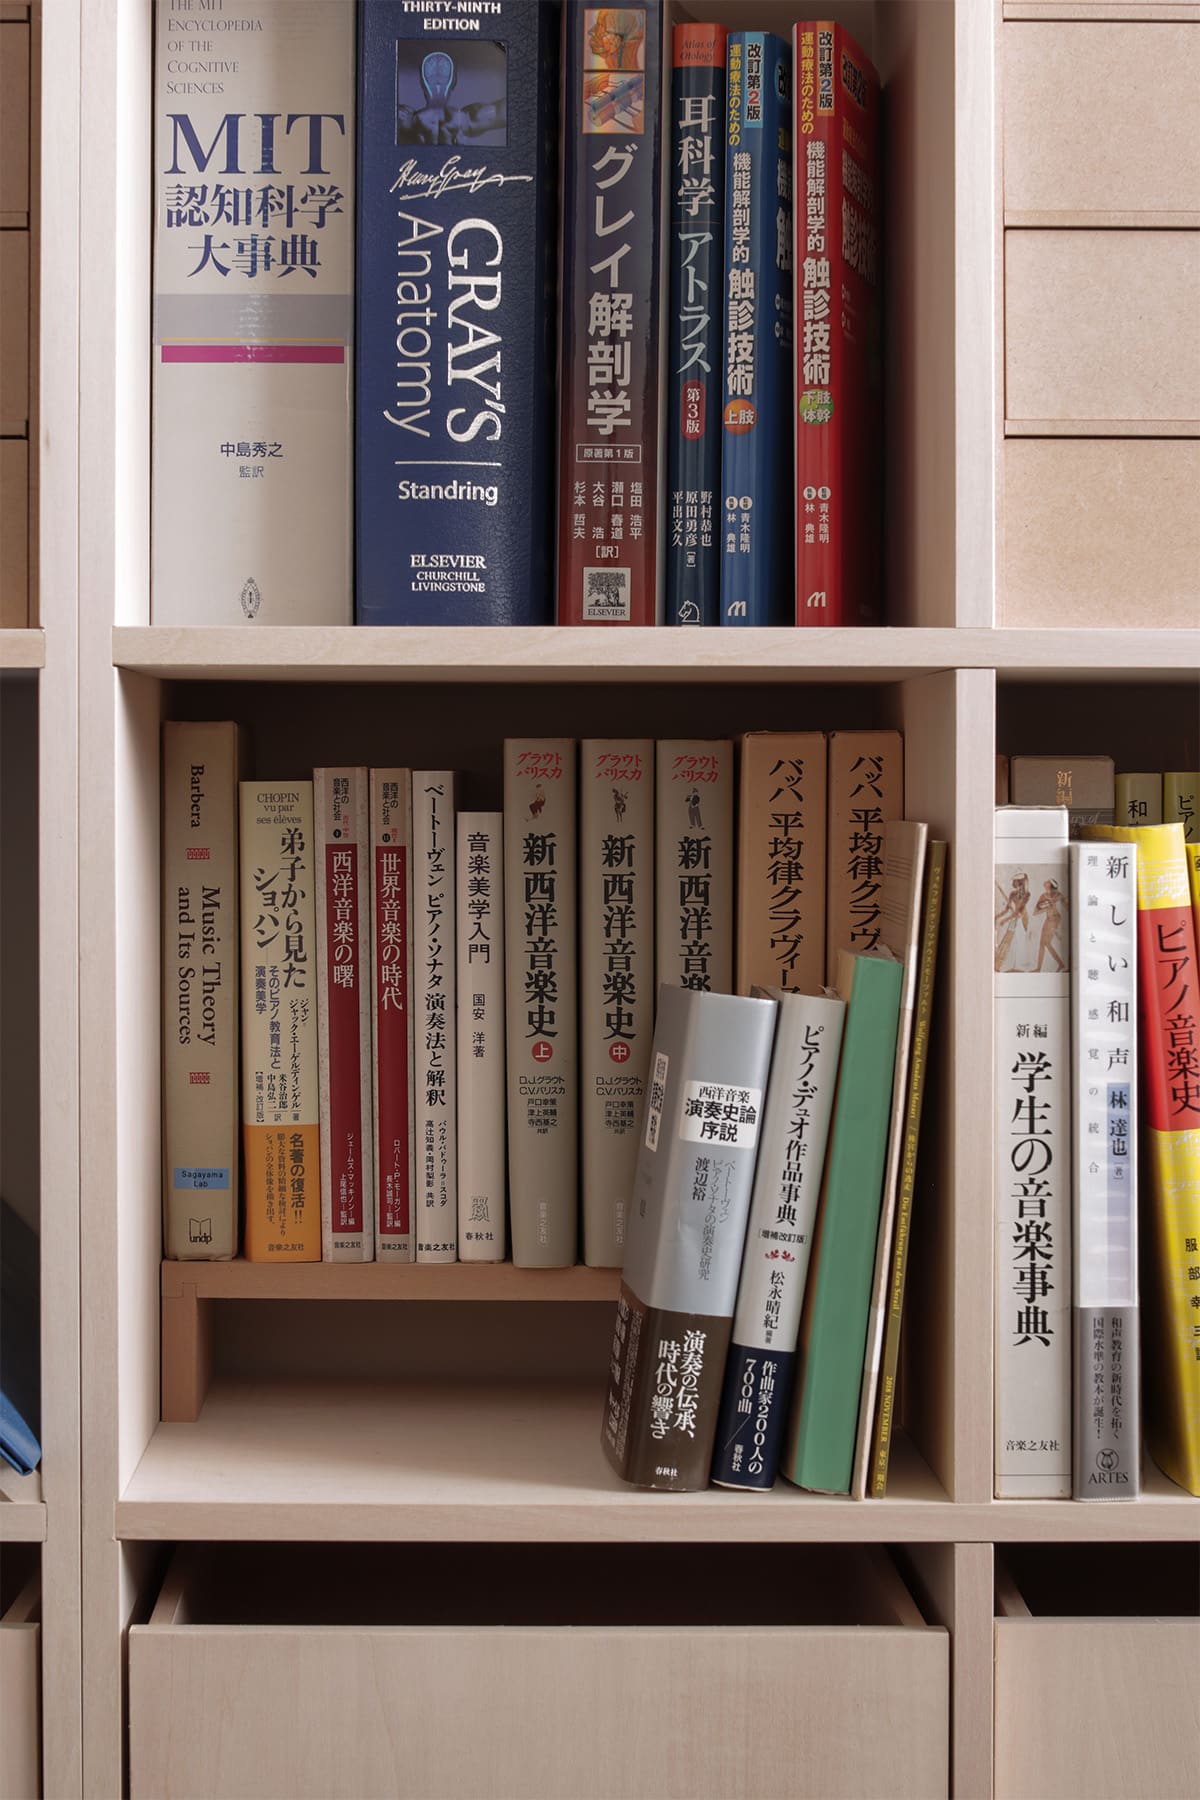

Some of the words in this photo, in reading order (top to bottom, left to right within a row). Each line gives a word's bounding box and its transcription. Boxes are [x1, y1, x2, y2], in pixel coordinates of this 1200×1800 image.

[167, 19, 263, 32] ENCYCLOPEDIA
[402, 1, 501, 14] THIRTY-NINTH
[423, 18, 480, 31] EDITION
[167, 41, 184, 52] OF
[188, 41, 213, 52] THE
[167, 61, 239, 74] COGNITIVE
[166, 82, 224, 94] SCIENCES
[747, 43, 762, 121] 改訂第2版
[801, 32, 814, 134] 運動療法のための
[818, 32, 833, 109] 改訂第2版
[728, 44, 742, 146] 運動療法のための
[164, 114, 345, 174] MIT
[677, 94, 716, 217] 耳科学
[165, 184, 345, 229] 認知科学
[732, 152, 751, 263] 機能解剖学的
[805, 141, 825, 252] 機能解剖学的
[187, 234, 322, 278] 大事典
[587, 143, 638, 435] グレイ解剖学
[675, 232, 713, 374] アトラス
[383, 211, 444, 437] Anatomy
[727, 268, 755, 396] 触診技術
[802, 257, 830, 385] 触診技術
[685, 387, 700, 433] 第3版
[724, 408, 754, 425] 上肢
[220, 442, 284, 458] 中島秀之
[239, 465, 264, 478] 監訳
[399, 480, 498, 506] Standring
[410, 555, 487, 569] ELSEVIER
[416, 571, 480, 581] CHURCHILL
[411, 582, 485, 592] LIVINGSTONE
[588, 608, 626, 616] ELSEVIER
[190, 764, 205, 828] Barbera
[257, 793, 300, 803] CHOPIN
[768, 759, 804, 802] バッハ
[849, 755, 884, 798] バッハ
[256, 816, 271, 825] ses
[264, 804, 276, 812] vu
[278, 804, 295, 814] par
[178, 887, 195, 925] and
[202, 886, 221, 955] Music
[251, 868, 280, 949] ショパン
[280, 827, 308, 989] 弟子から見た
[332, 850, 355, 988] 西洋音楽の曙
[467, 832, 491, 964] 音楽美学入門
[178, 932, 195, 959] Its
[380, 853, 403, 1011] 世界音楽の時代
[523, 832, 558, 1038] 新西洋音楽史
[602, 834, 637, 1040] 新西洋音楽史
[1107, 856, 1129, 1071] 新しい和声
[178, 966, 195, 1045] Sources
[197, 962, 222, 1046] Theory
[1157, 919, 1200, 1116] ピアノ音楽史
[535, 1044, 549, 1058] 上
[612, 1045, 627, 1060] 中
[1016, 1023, 1048, 1039] 新編
[685, 1097, 756, 1125] 演奏史論
[699, 1085, 750, 1104] 西洋音楽
[700, 1121, 738, 1143] 序説
[775, 1025, 825, 1226] ピアノ・デュオ作品事典
[181, 1170, 223, 1180] Sagayama
[194, 1180, 208, 1188] Lab
[692, 1156, 711, 1202] 渡辺裕
[1011, 1051, 1054, 1347] 学生の音楽事典
[465, 1232, 494, 1241] 春秋社
[763, 1269, 785, 1330] 松永晴紀
[650, 1339, 681, 1439] 時代の響き
[737, 1358, 757, 1414] 700曲
[748, 1360, 778, 1474] 作曲家200人の
[1005, 1440, 1061, 1451] 音楽之友社
[1088, 1472, 1129, 1484] ARTES
